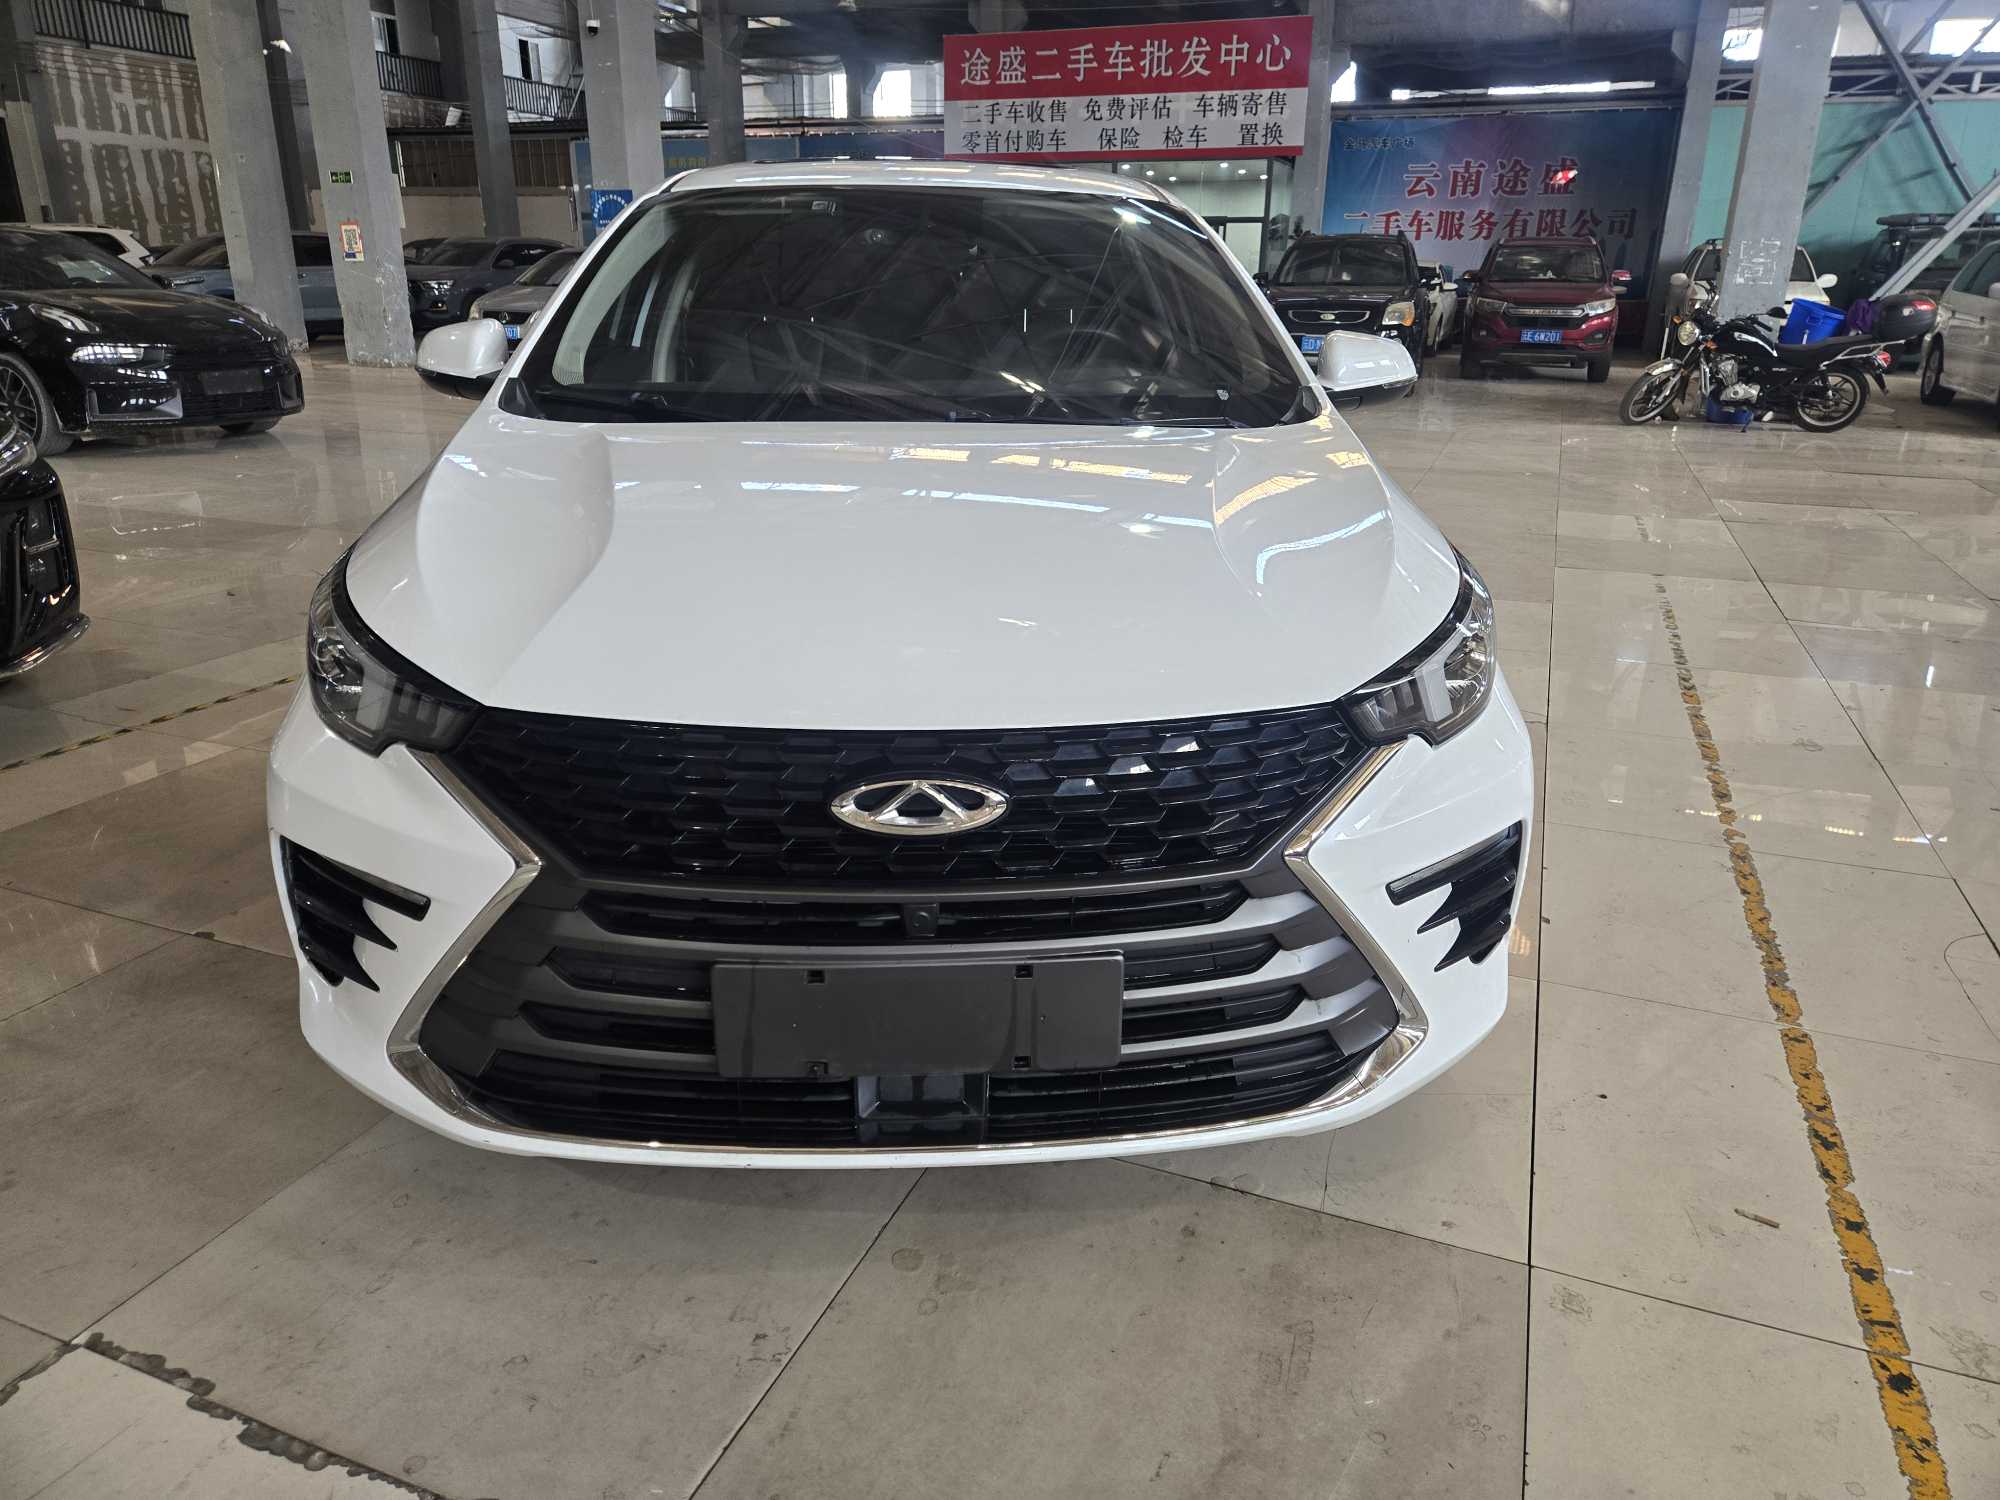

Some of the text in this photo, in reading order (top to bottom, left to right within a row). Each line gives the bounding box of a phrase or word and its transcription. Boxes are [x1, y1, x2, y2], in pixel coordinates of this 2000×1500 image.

[960, 33, 1292, 86] 途盛二手车批发中心
[962, 91, 1288, 125] 二手车收售 免费评估 车辆寄售
[962, 122, 1284, 154] 零首付购车 保险 检车 置换
[1403, 156, 1580, 200] 云南途盛
